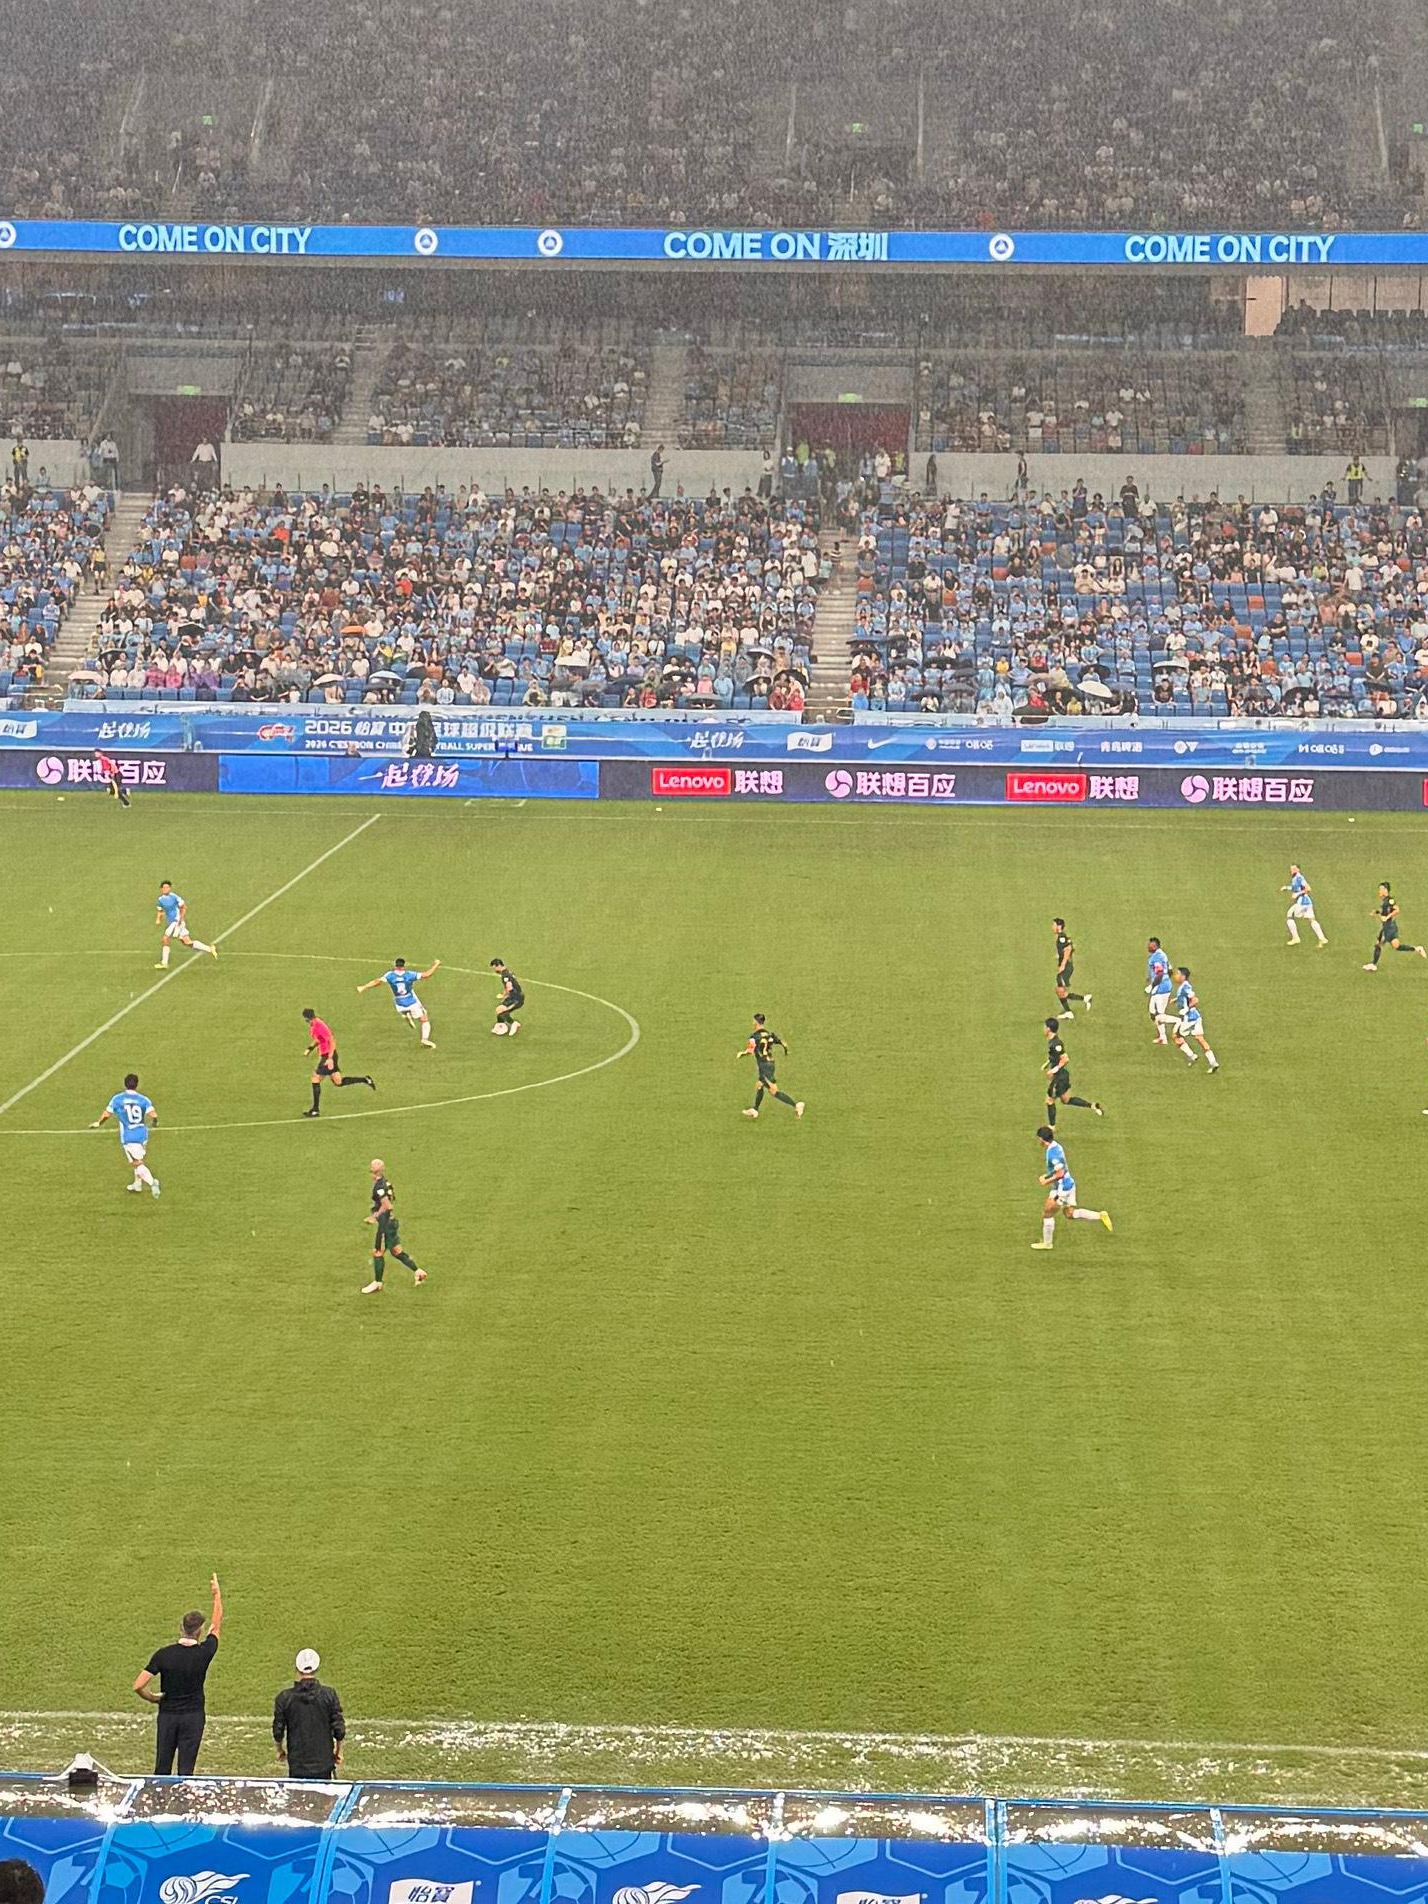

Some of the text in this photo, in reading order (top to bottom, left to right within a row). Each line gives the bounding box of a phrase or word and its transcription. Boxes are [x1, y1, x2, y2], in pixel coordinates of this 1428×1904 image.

[118, 224, 311, 254] COME ON CITY
[663, 231, 889, 261] COME ON 深圳
[1125, 235, 1334, 263] COME ON CITY
[305, 720, 353, 734] 2026
[659, 770, 784, 795] Lenovo 联想
[856, 772, 956, 798] 联想百应
[1013, 776, 1140, 801] Lenovo 联想
[1213, 778, 1315, 804] 联想百应
[123, 1104, 143, 1124] 19
